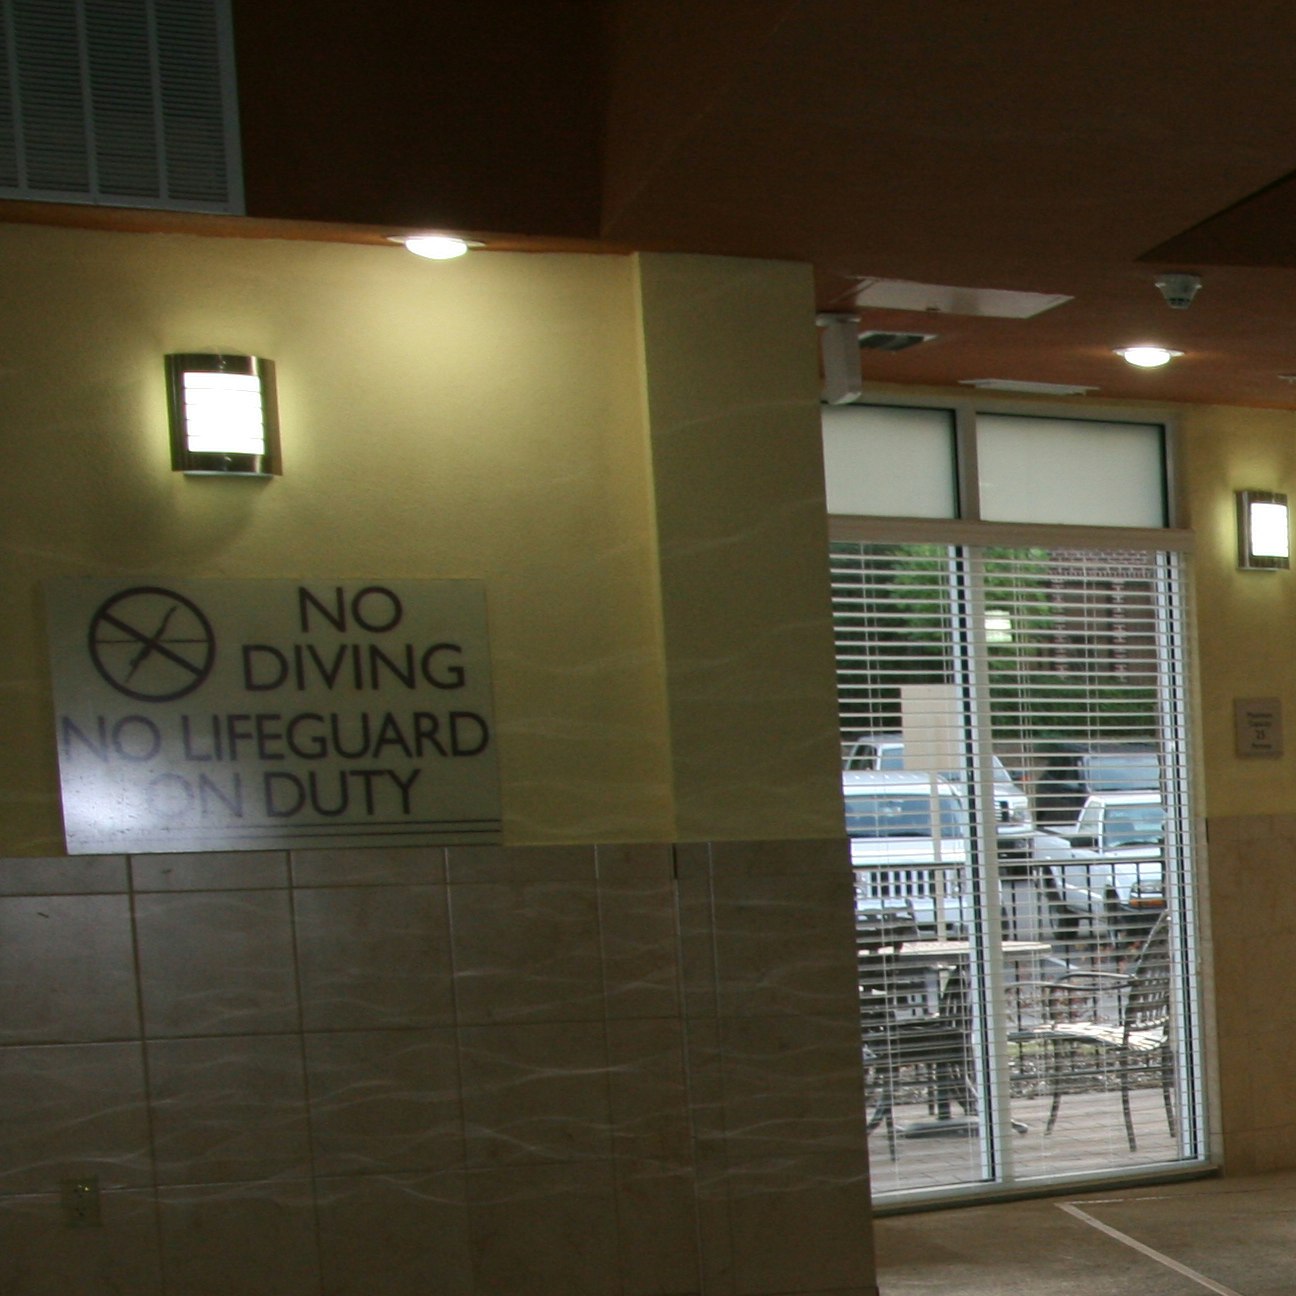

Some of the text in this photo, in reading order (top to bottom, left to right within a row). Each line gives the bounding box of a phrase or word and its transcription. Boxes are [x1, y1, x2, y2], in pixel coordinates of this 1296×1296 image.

[299, 586, 403, 634] NO
[242, 643, 466, 692] DIVING
[62, 710, 490, 763] NO LIFEGUARD
[147, 768, 422, 819] ON DUTY
